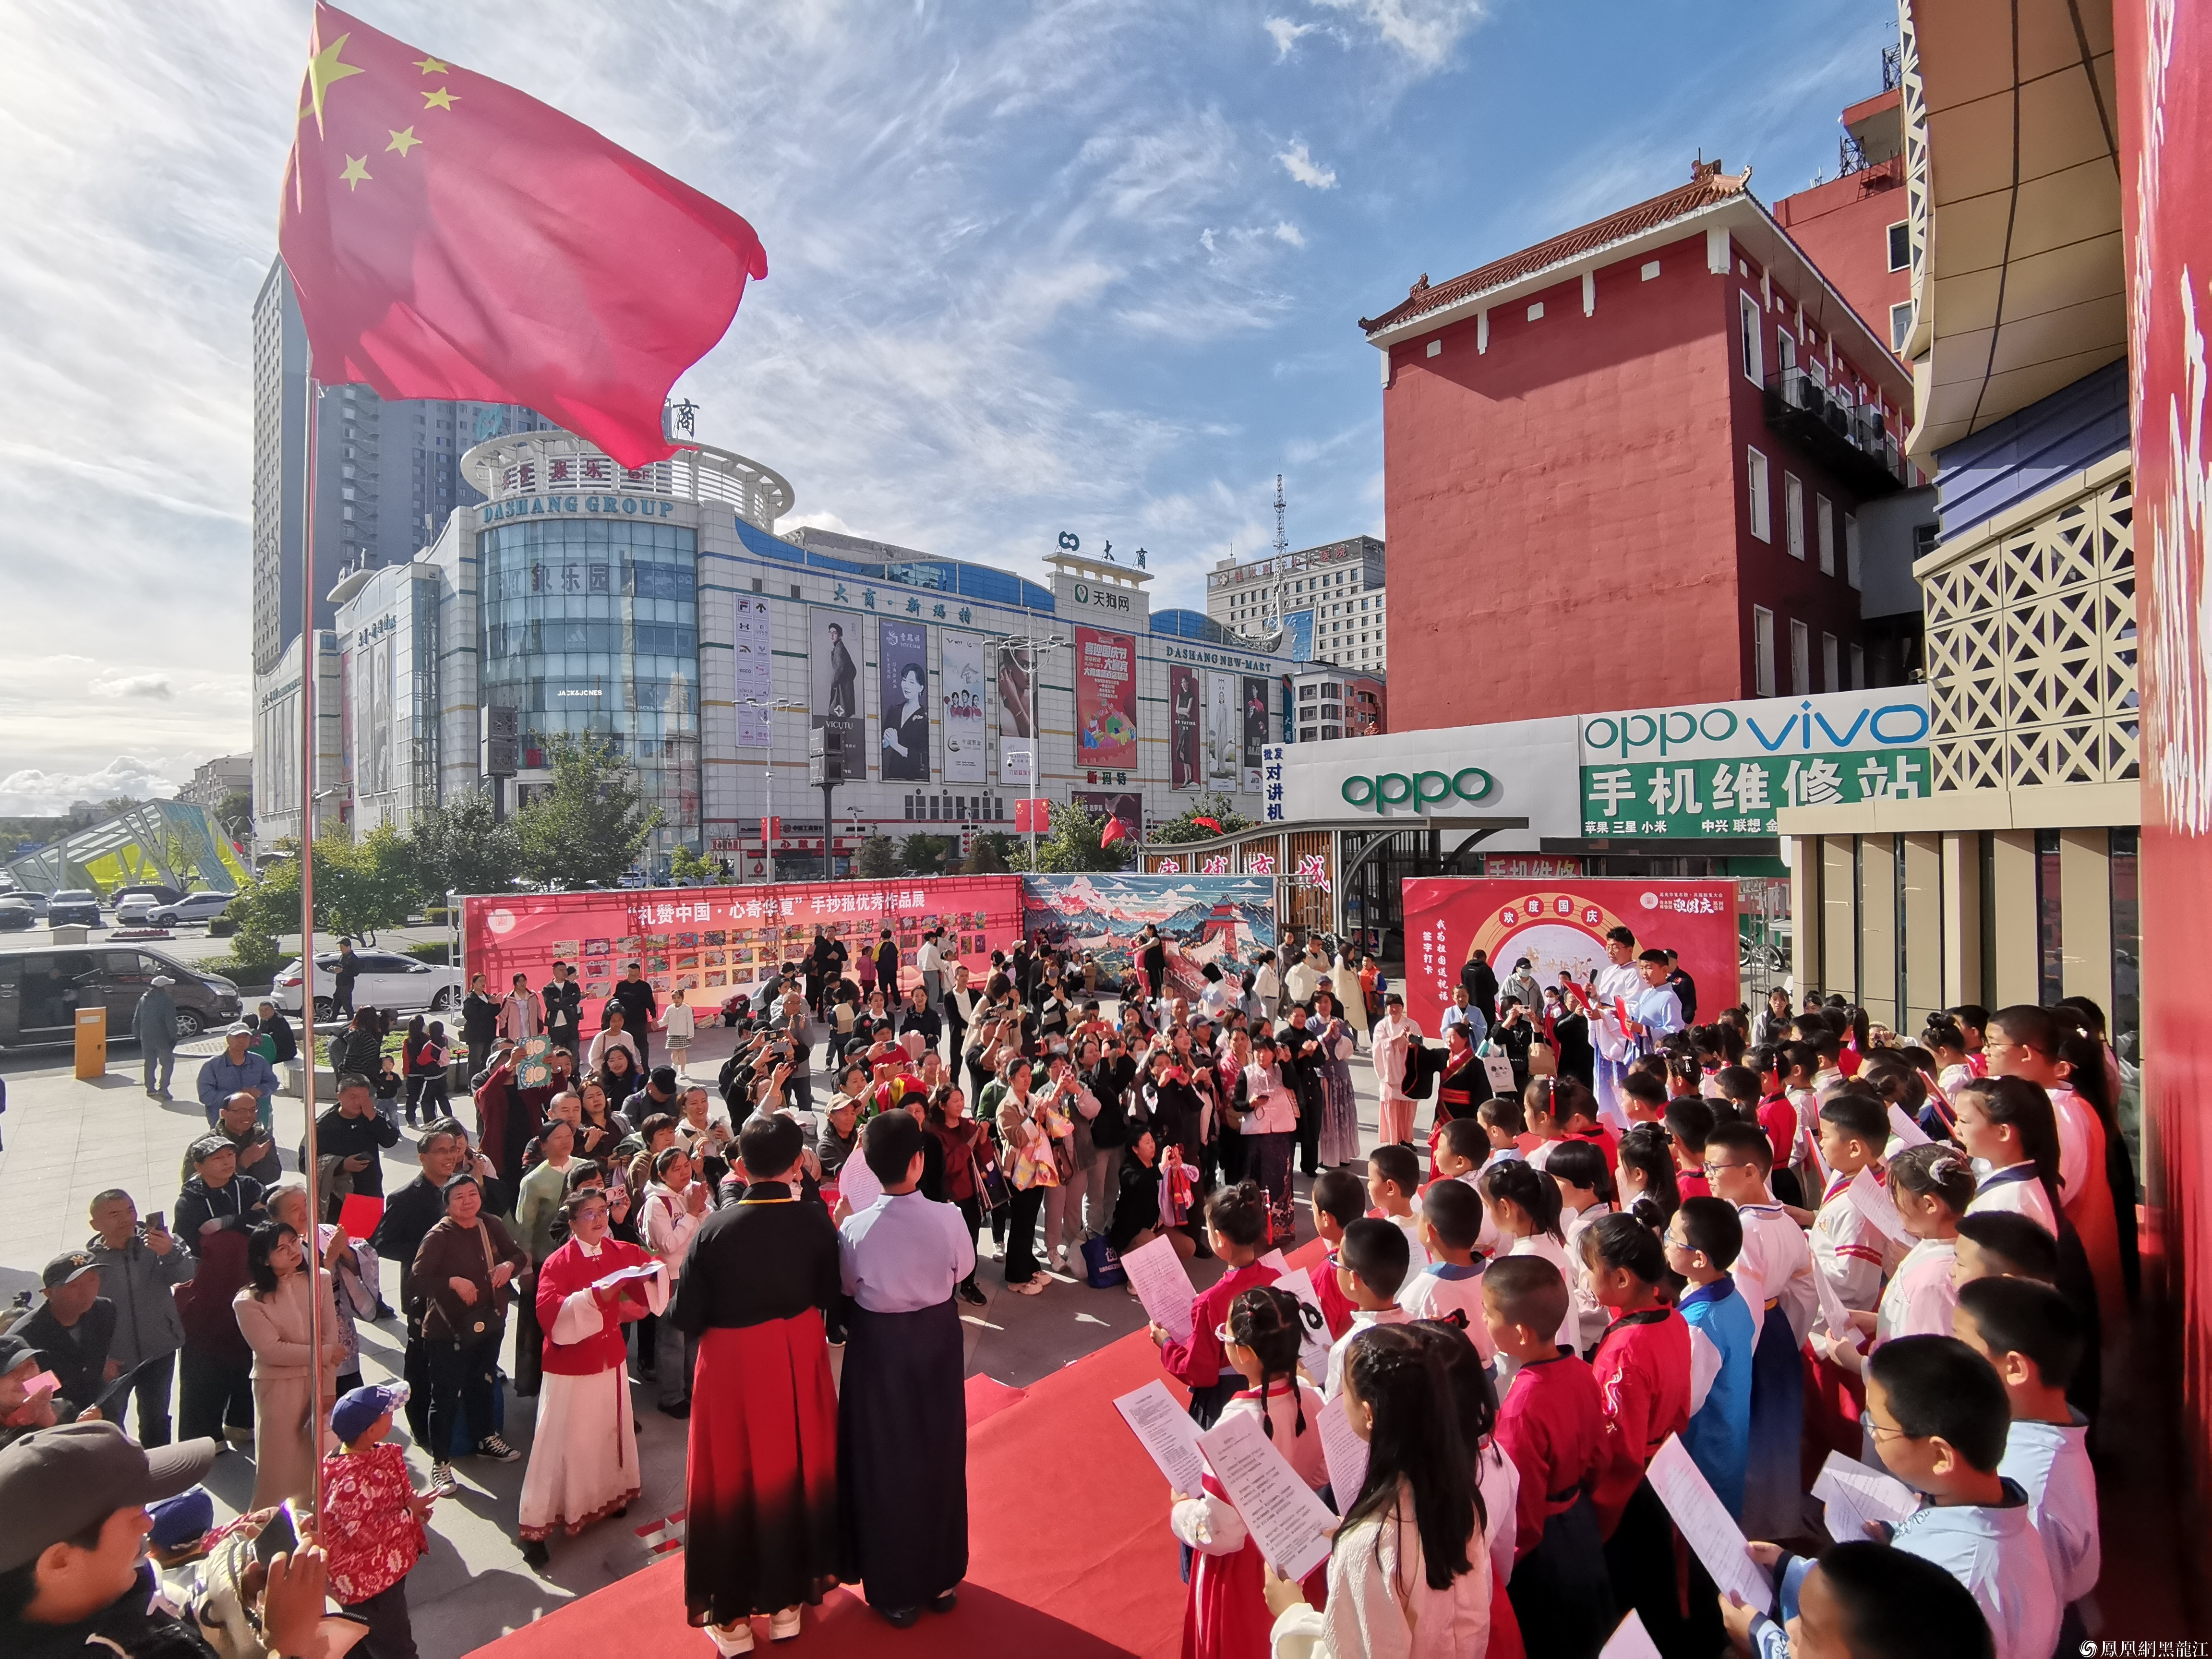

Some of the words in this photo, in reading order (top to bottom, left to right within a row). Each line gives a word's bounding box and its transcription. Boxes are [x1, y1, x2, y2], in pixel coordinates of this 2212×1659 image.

[484, 496, 578, 523] DASHANG
[585, 497, 674, 517] GROUP
[1235, 545, 1347, 582] 佳木斯中心医院
[1093, 590, 1130, 612] 天狗网
[1166, 646, 1218, 664] DASHANG
[1220, 655, 1272, 673] NEW-MART
[825, 720, 854, 730] VICUTU
[1585, 708, 1738, 759] oppo
[1745, 699, 1929, 751] vivo
[1087, 770, 1127, 785] 新玛特
[1341, 767, 1494, 814] oppo
[1588, 755, 1922, 817] 手机维修站
[1265, 762, 1285, 821] 对讲机
[1585, 820, 1609, 834] 苹果
[1612, 820, 1637, 834] 三星
[1641, 820, 1667, 834] 小米
[1702, 819, 1729, 833] 中兴
[1733, 818, 1761, 832] 联想
[811, 890, 926, 914] 手抄报优秀作品展
[1503, 900, 1598, 924] 欢度国庆
[1673, 897, 1715, 914] 迎国庆
[1422, 931, 1433, 974] 签字打卡
[1436, 918, 1449, 1001] 我为祖国送祝福
